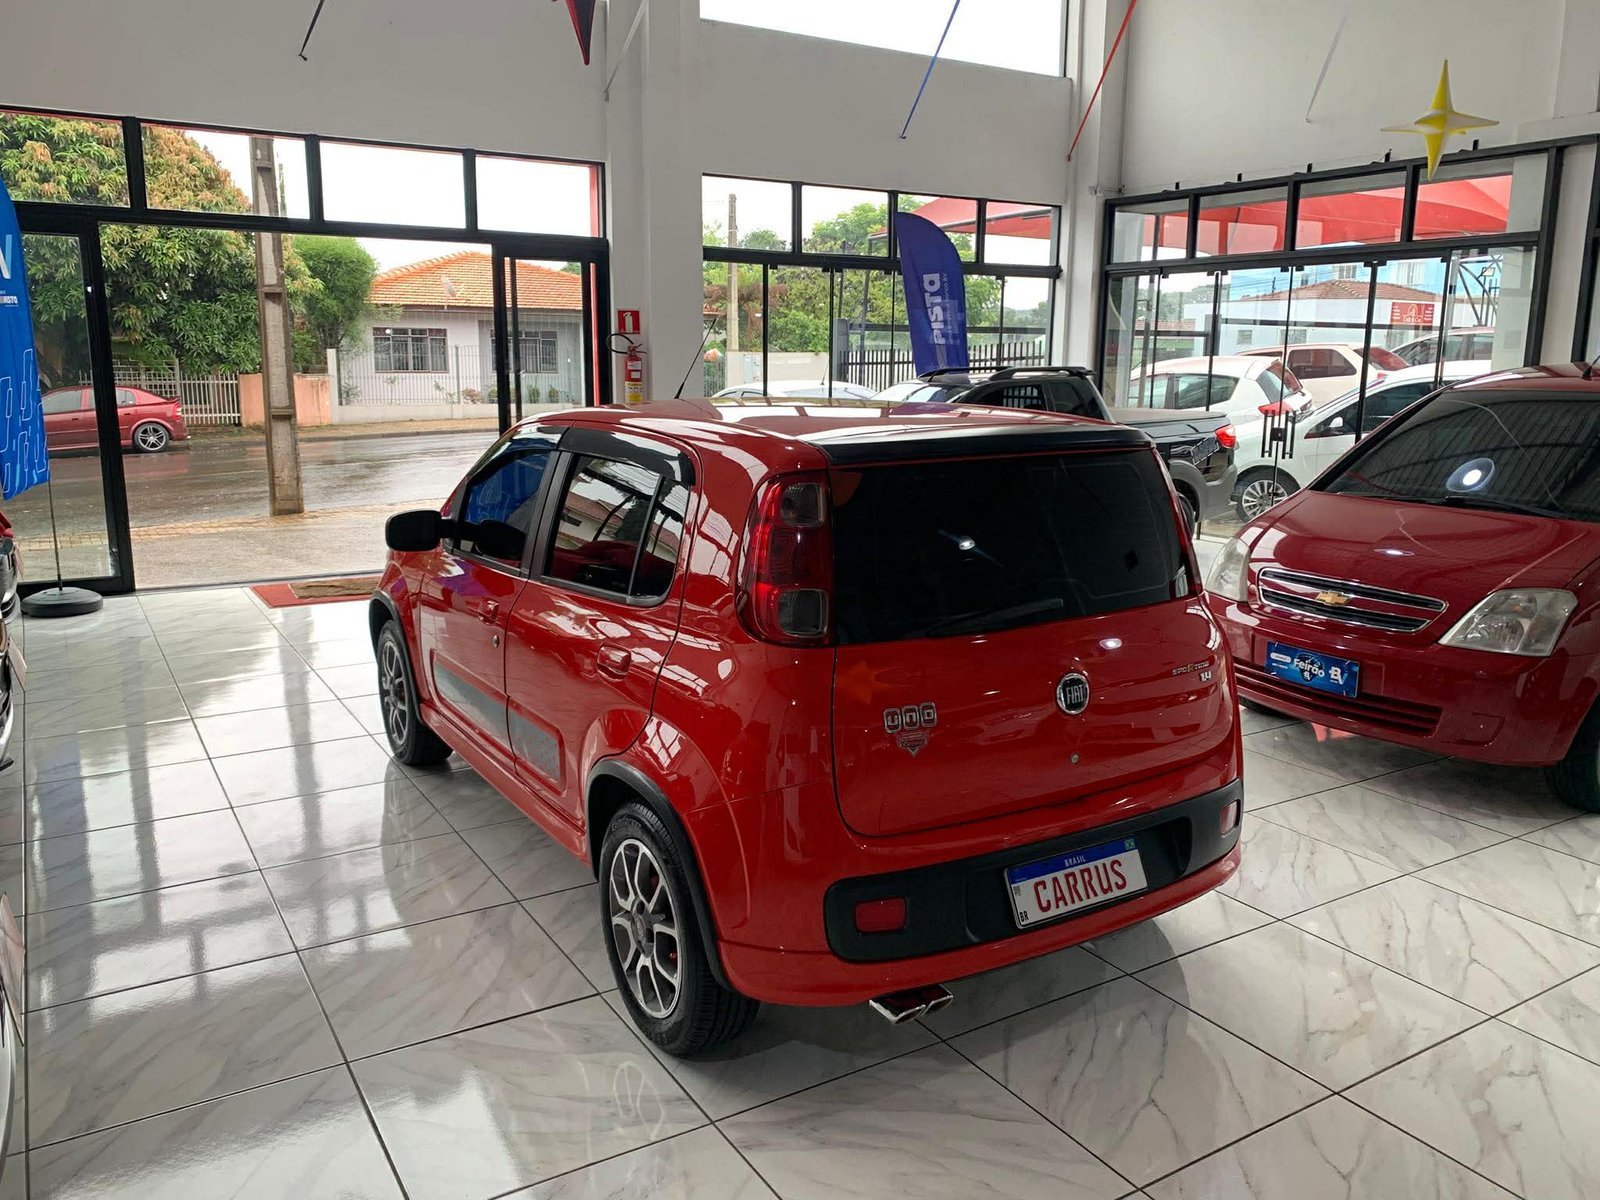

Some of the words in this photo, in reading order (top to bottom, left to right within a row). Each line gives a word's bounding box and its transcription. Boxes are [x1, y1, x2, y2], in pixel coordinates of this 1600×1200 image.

[1294, 658, 1325, 677] Feirão
[1066, 684, 1084, 705] FIAT
[1064, 855, 1087, 867] BRASIL
[1034, 859, 1128, 912] CARRUS
[1020, 911, 1029, 922] BR
